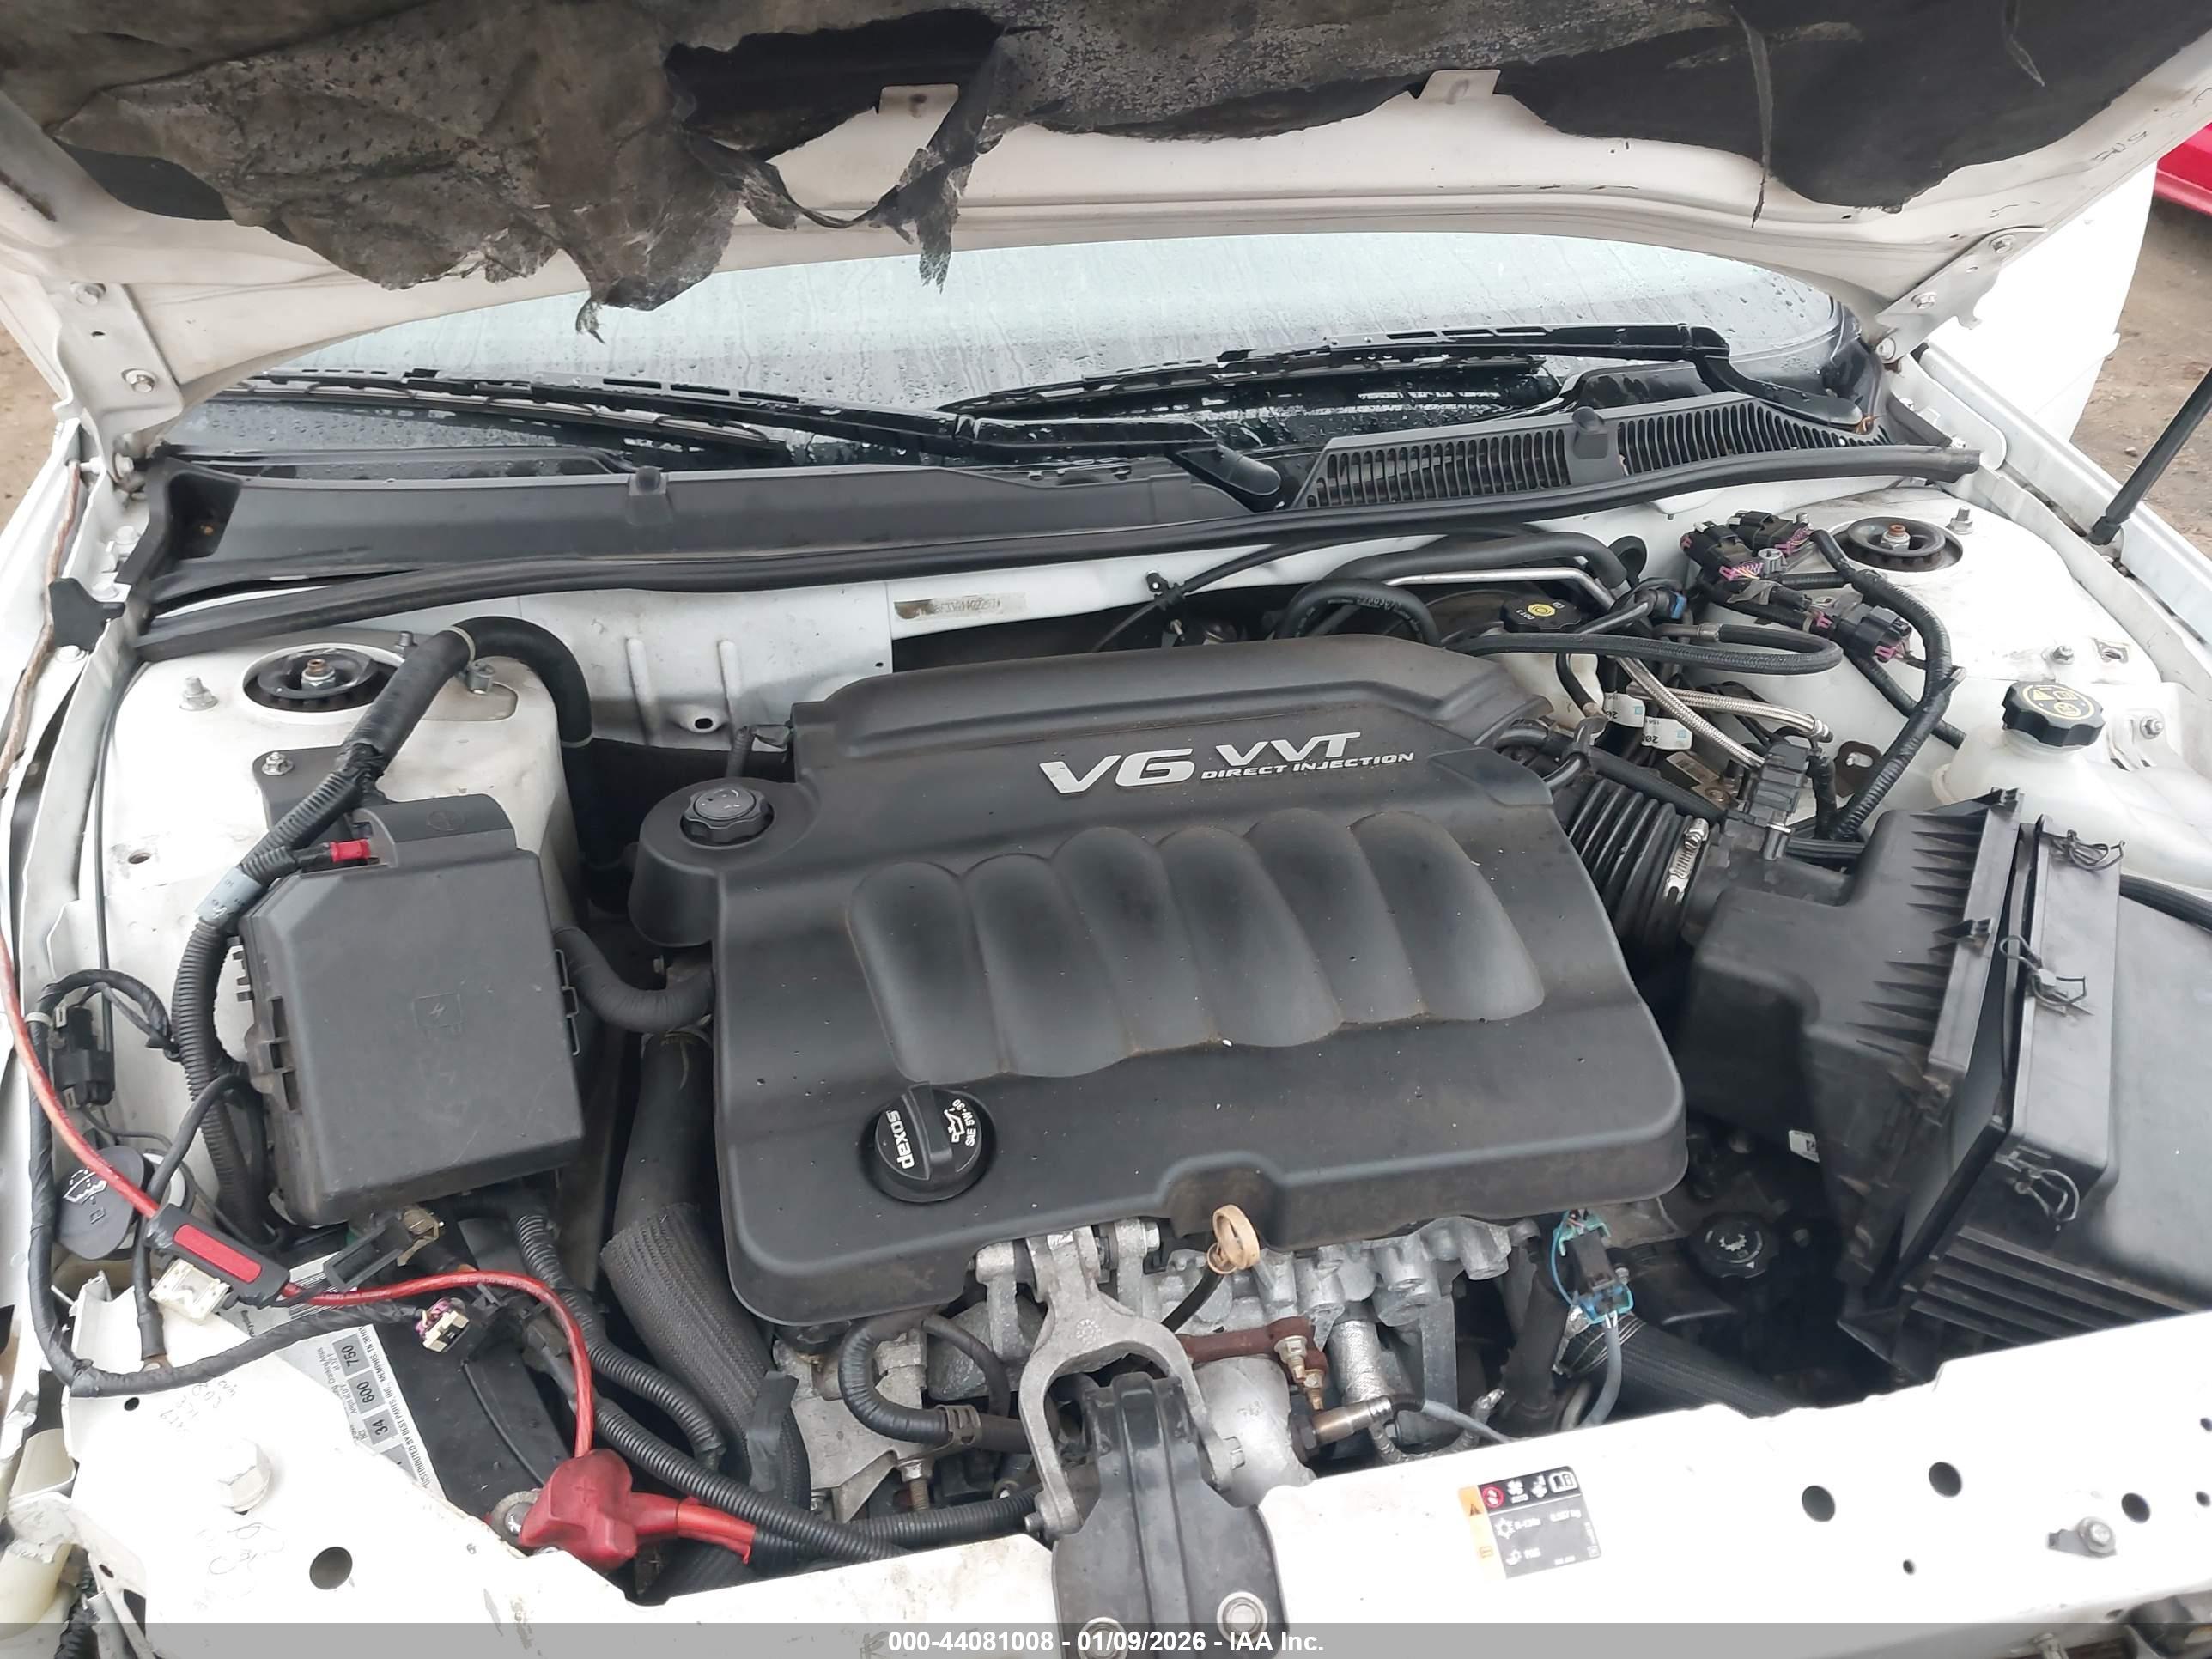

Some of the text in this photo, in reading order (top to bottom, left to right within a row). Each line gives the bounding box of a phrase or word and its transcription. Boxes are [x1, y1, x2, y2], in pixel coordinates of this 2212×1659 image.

[1215, 732, 1361, 767] VVT
[1039, 748, 1194, 795] V6
[1200, 751, 1414, 781] DIRECT INJECTION
[885, 1109, 915, 1170] dexos
[964, 1127, 976, 1147] SAE
[342, 1344, 360, 1367] 750
[356, 1381, 374, 1404] 600
[372, 1419, 389, 1436] 34
[398, 1419, 409, 1436] BEST
[408, 1445, 431, 1487] DISTRIBUTED
